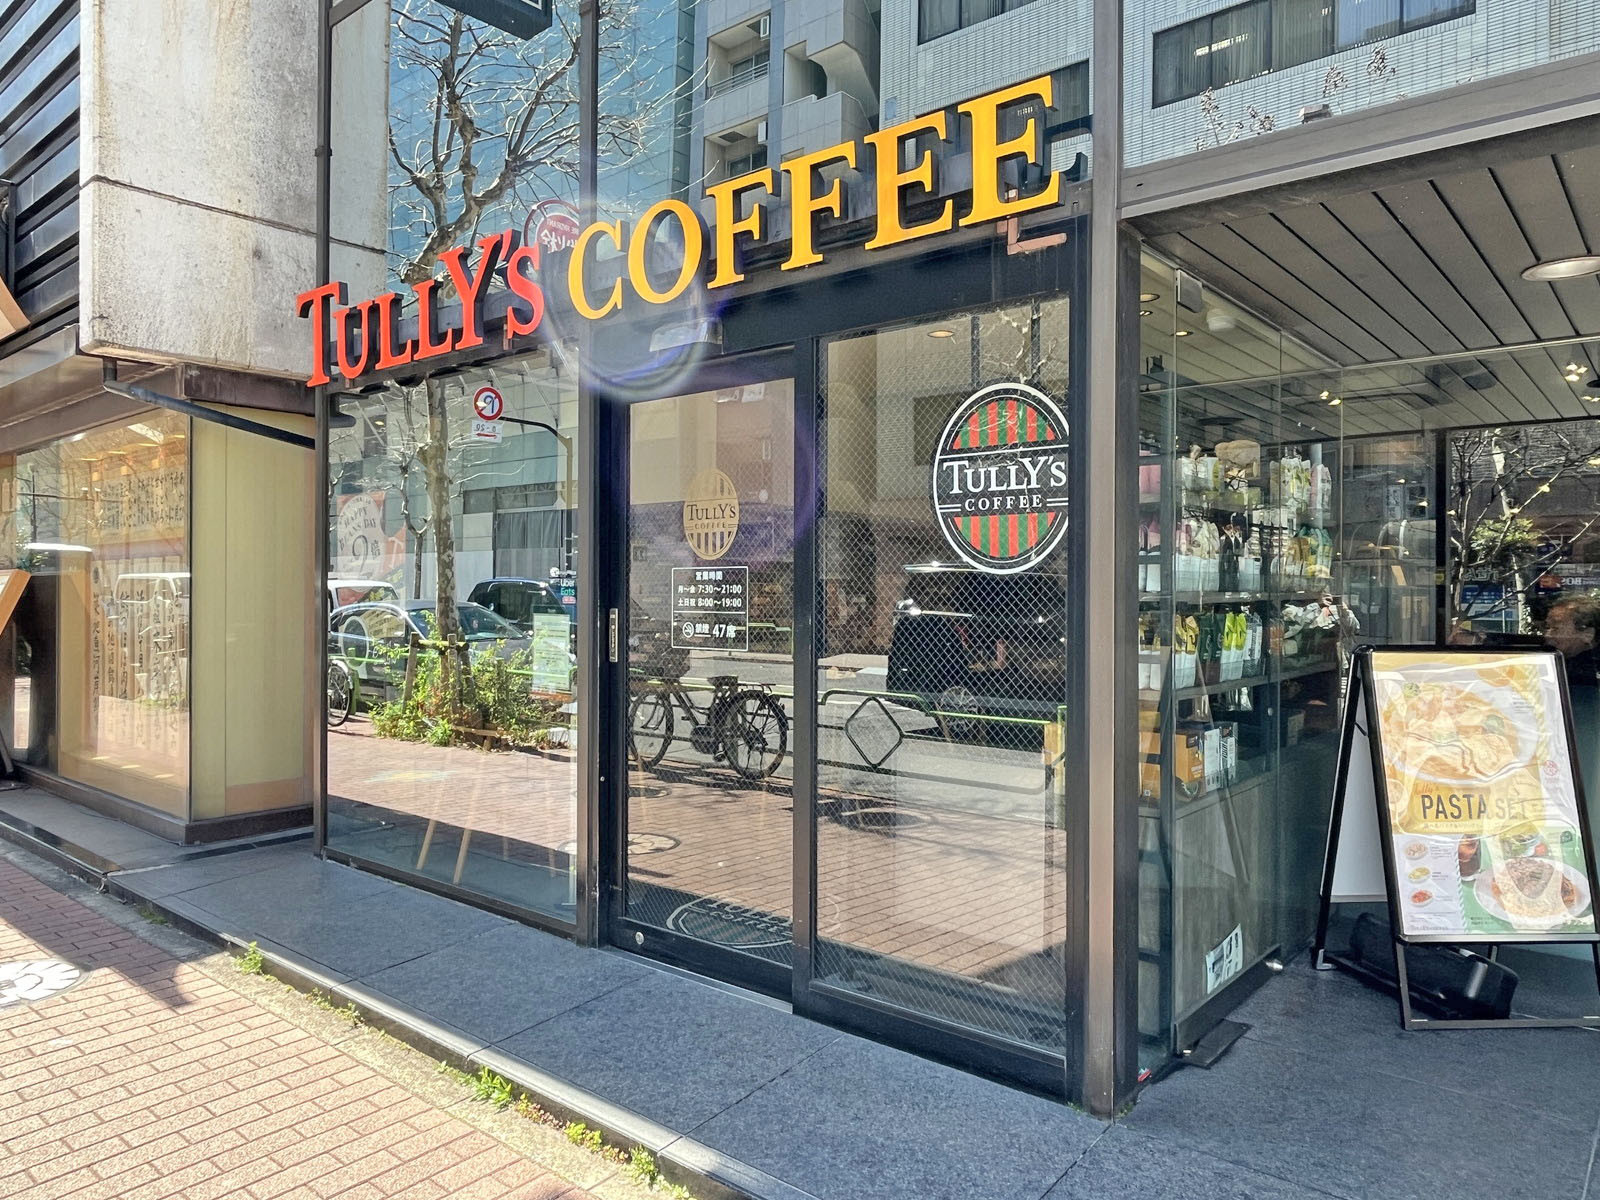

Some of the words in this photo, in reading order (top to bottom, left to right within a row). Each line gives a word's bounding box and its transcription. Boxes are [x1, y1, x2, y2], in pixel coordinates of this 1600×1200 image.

[296, 229, 545, 388] TULLY'S
[567, 75, 1062, 320] COFFEE
[943, 455, 1067, 494] TULLY'S
[964, 494, 1042, 511] COFFEE
[686, 503, 736, 521] TULLY'S
[560, 579, 575, 587] Uber
[560, 588, 575, 596] Eats
[1420, 793, 1491, 820] PASTA
